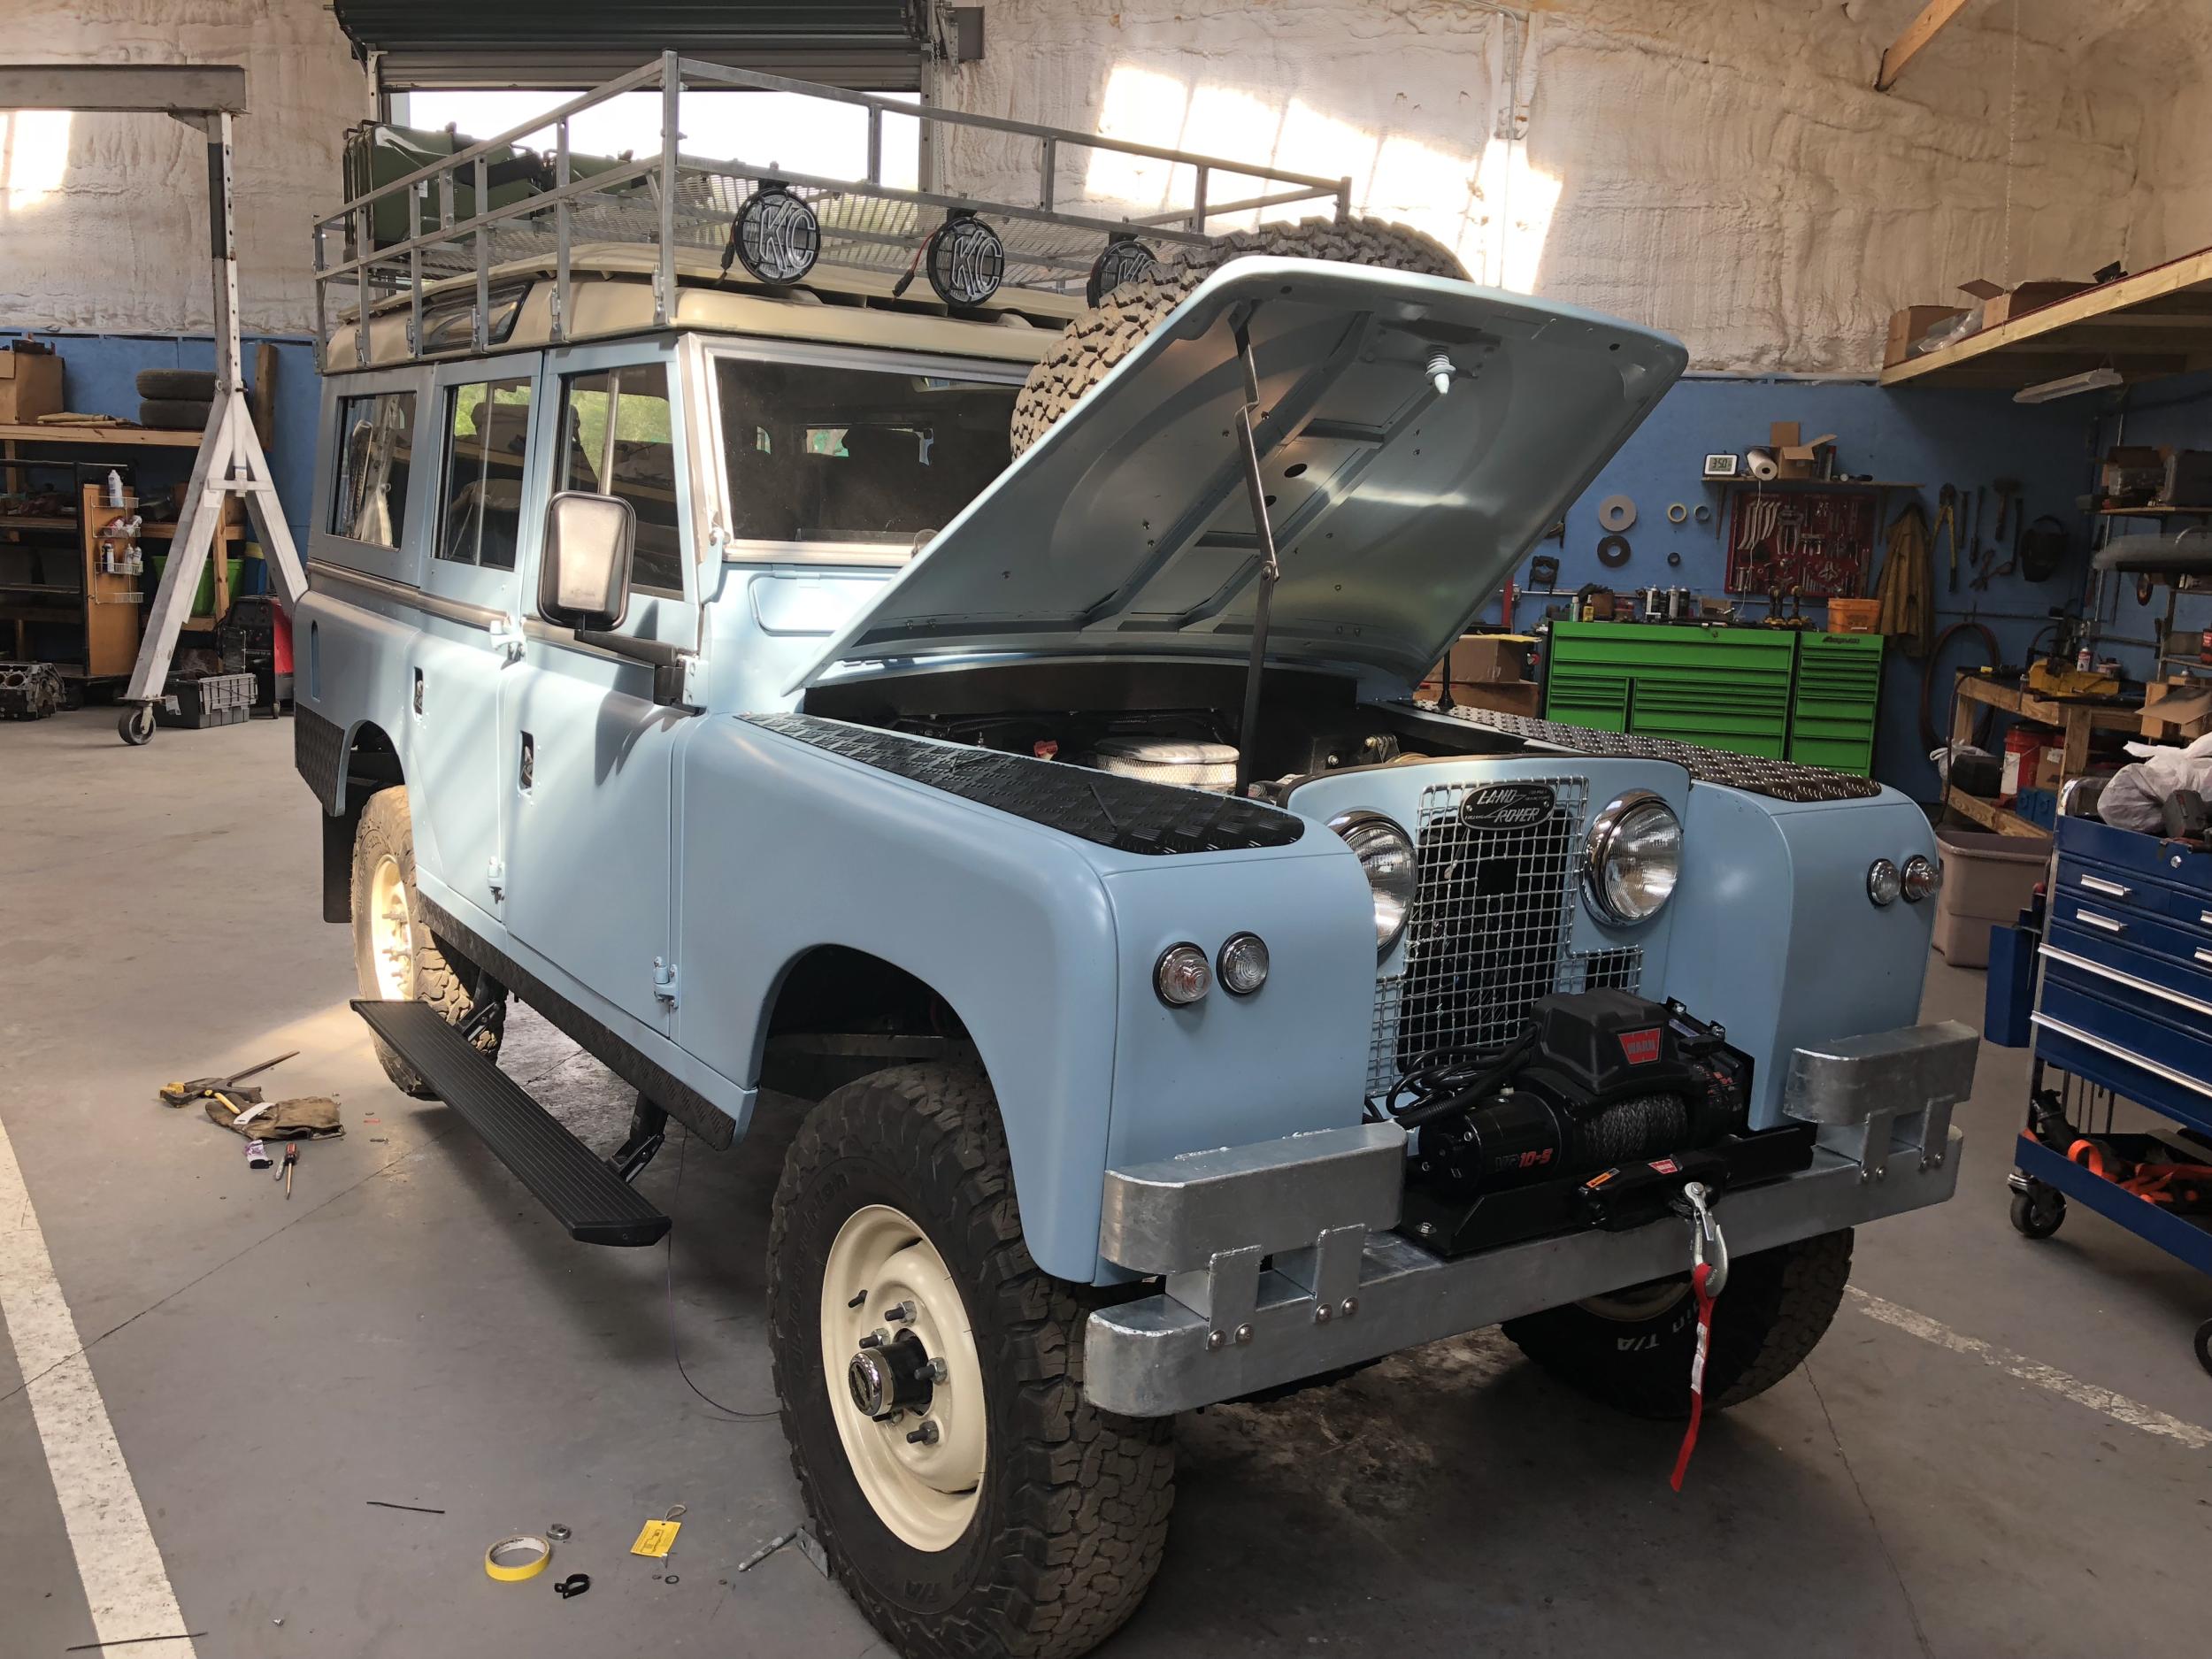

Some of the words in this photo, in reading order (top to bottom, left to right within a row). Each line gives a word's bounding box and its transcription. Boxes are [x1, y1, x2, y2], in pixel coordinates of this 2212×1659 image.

[759, 200, 816, 272] KC
[952, 230, 1002, 296] KC
[1476, 788, 1518, 805] LAND
[1494, 807, 1540, 823] ROVER
[1617, 1333, 1661, 1351] T/A
